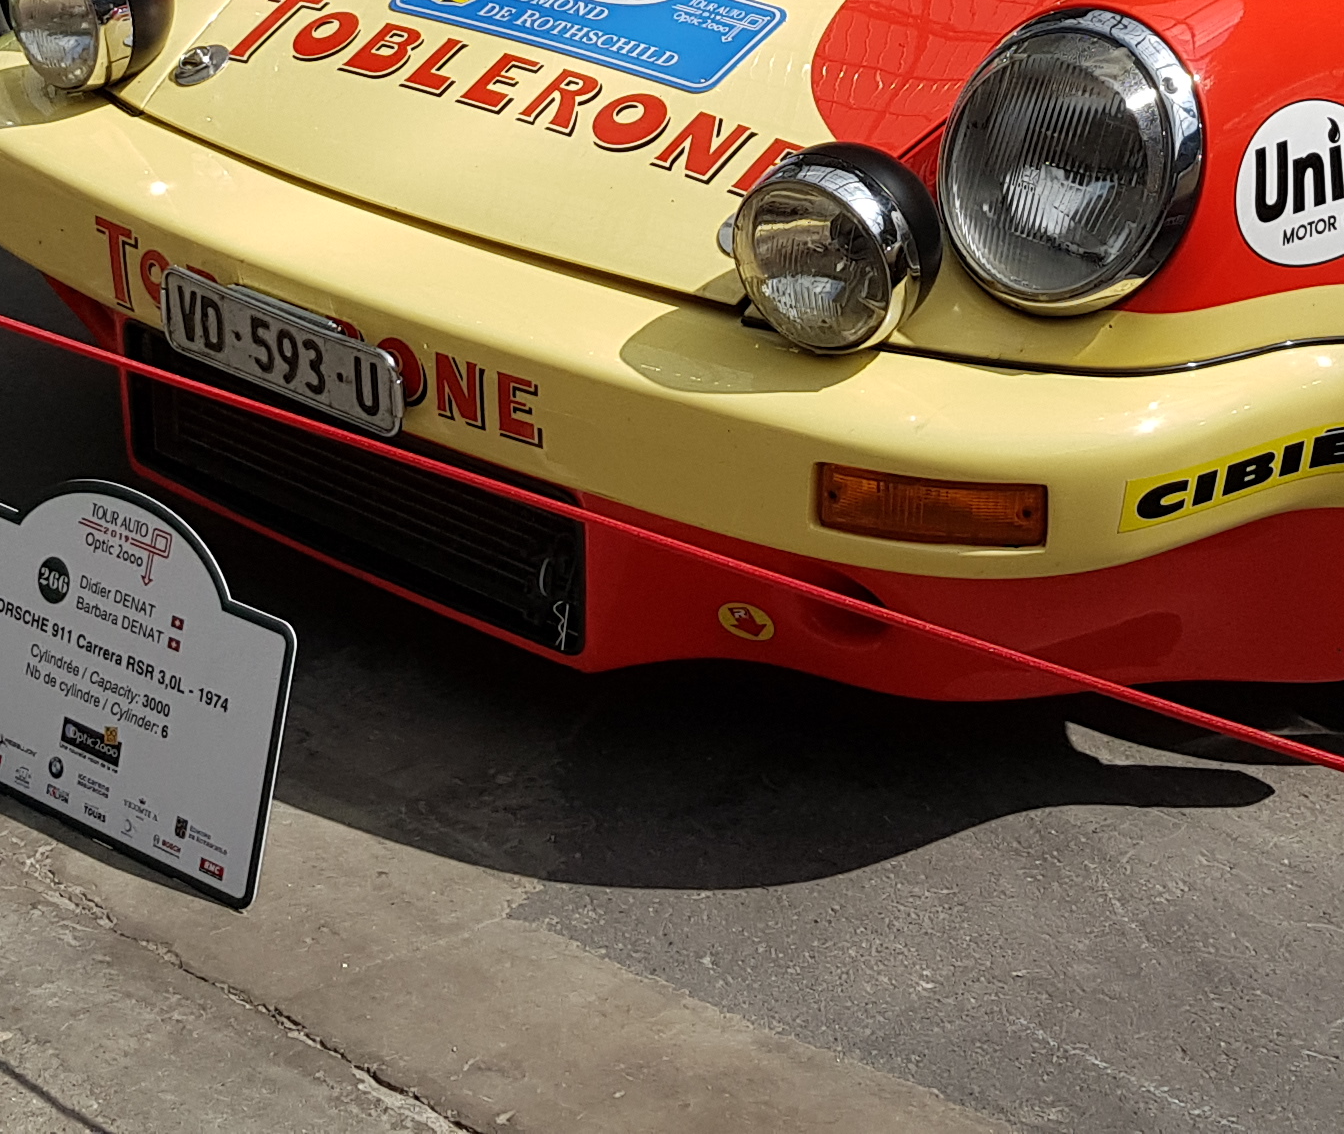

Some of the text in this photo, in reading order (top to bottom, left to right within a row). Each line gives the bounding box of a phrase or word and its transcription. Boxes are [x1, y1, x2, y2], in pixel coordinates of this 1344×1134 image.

[673, 12, 701, 27] Optic
[687, 0, 746, 19] TOUR AUTO
[476, 2, 680, 67] DE ROTHSCHILD
[1282, 218, 1338, 248] MOTOR
[92, 502, 149, 538] TOUR AUTO
[103, 526, 130, 543] 2019
[85, 532, 144, 567] Optic 2000
[38, 566, 69, 594] 266
[80, 575, 156, 618] Didier DENAT
[76, 595, 164, 645] Barbara DENAT
[30, 643, 80, 677] Cylindrée
[89, 670, 140, 704] Capacity:
[142, 694, 171, 718] 3000
[51, 623, 73, 644] 911
[76, 633, 123, 666] Carrera
[125, 655, 155, 681] RSR
[157, 669, 185, 695] 3,0L
[198, 687, 229, 713] 1974
[25, 662, 42, 681] Nb
[43, 672, 57, 688] de
[59, 676, 101, 708] cylindre
[110, 701, 159, 735] Cylinder:
[160, 724, 169, 739] 6
[84, 804, 107, 823] TOURS
